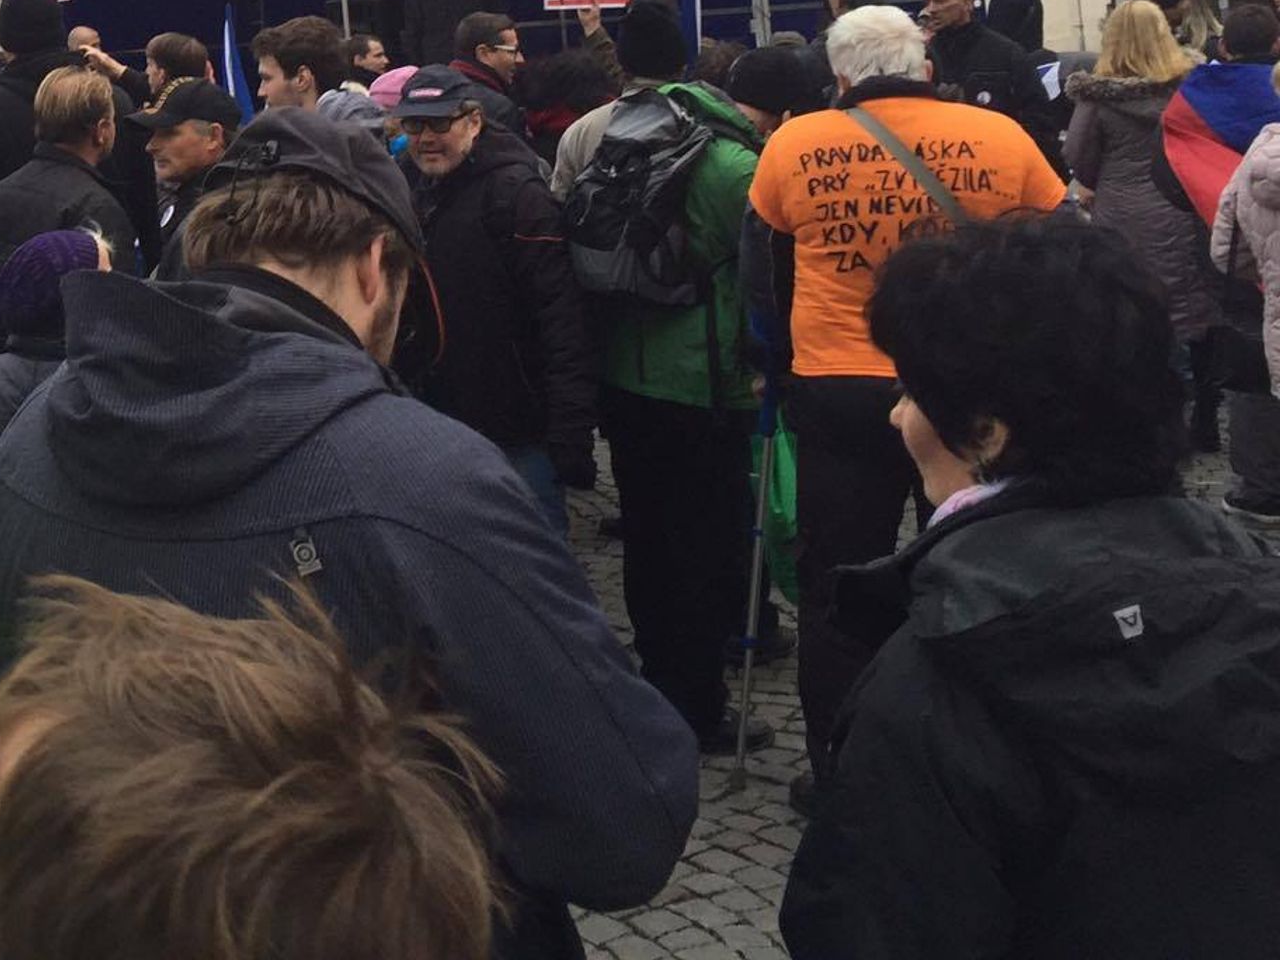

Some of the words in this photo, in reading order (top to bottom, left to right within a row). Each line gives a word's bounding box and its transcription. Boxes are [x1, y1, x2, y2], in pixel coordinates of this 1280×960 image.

[807, 168, 851, 197] PRÝ
[815, 199, 859, 222] JEN
[826, 250, 873, 273] ZA
